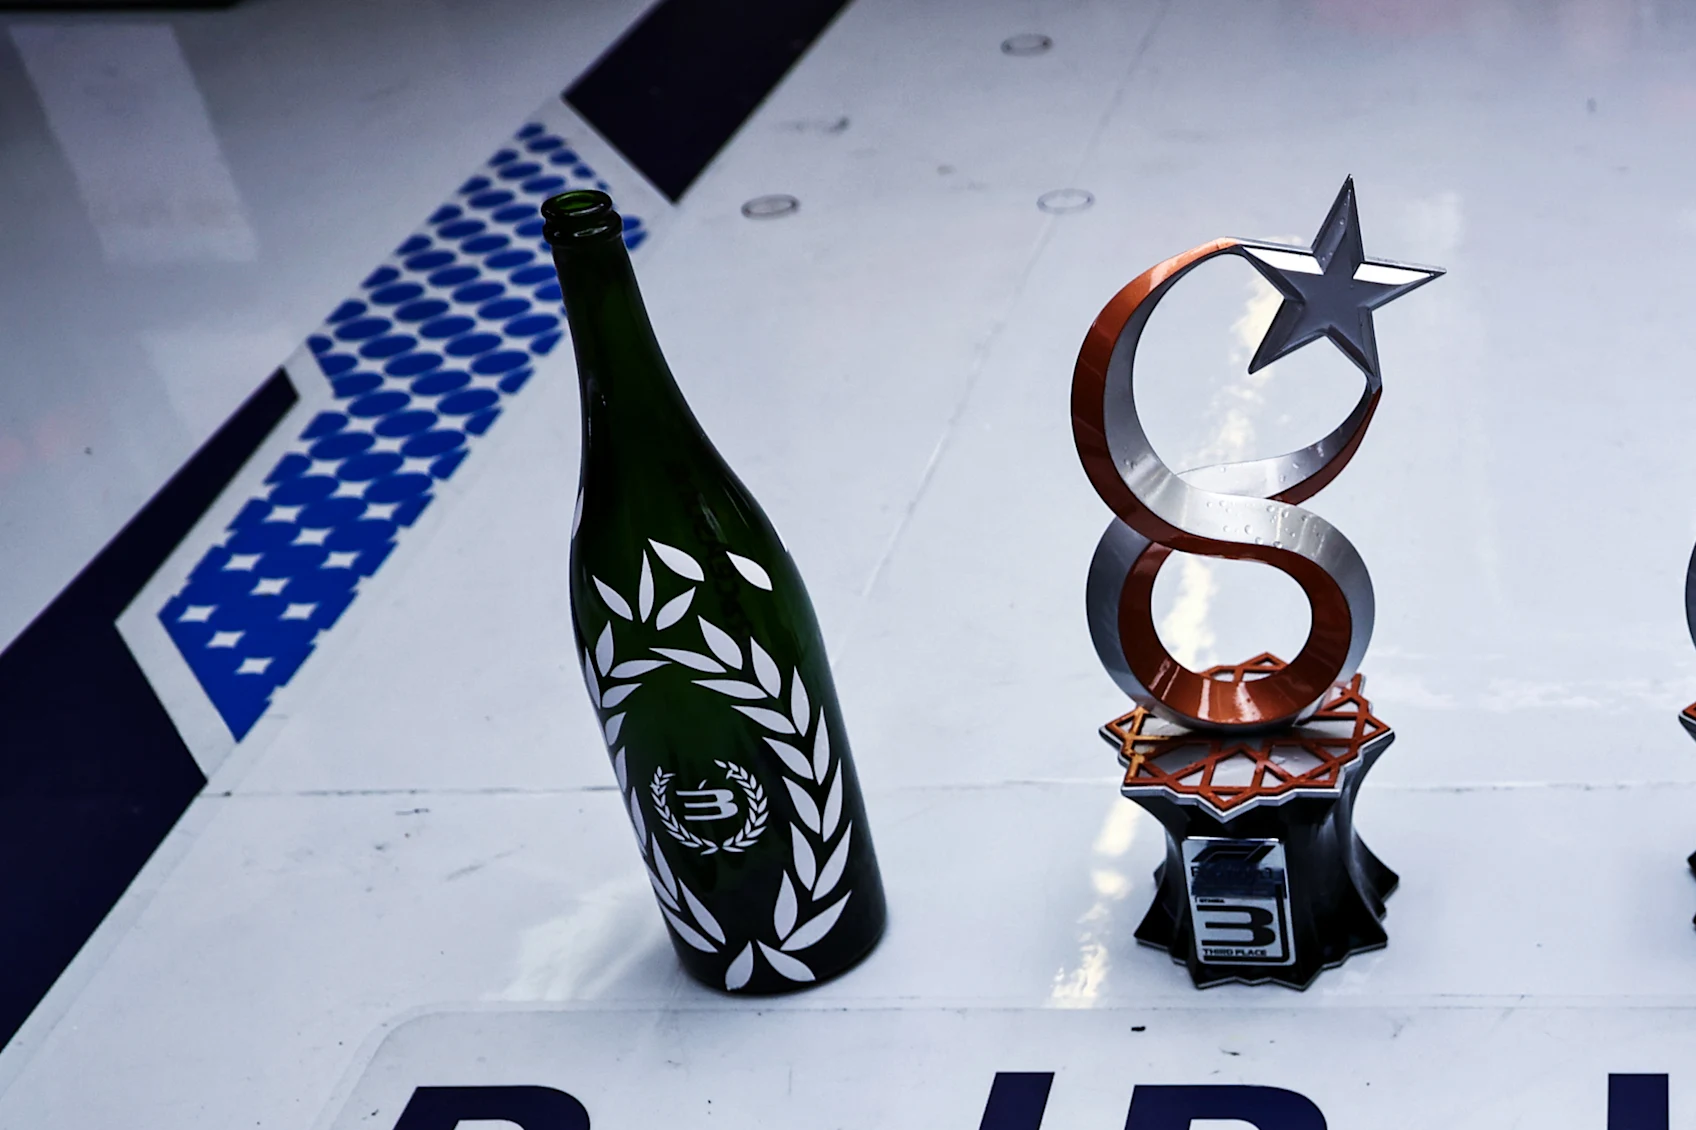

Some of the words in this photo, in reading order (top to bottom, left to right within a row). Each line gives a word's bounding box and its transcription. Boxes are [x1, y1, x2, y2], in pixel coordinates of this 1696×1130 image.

[676, 789, 738, 820] 3
[1196, 904, 1276, 947] 3
[1203, 948, 1234, 956] THIRD
[1235, 949, 1267, 957] PLACE
